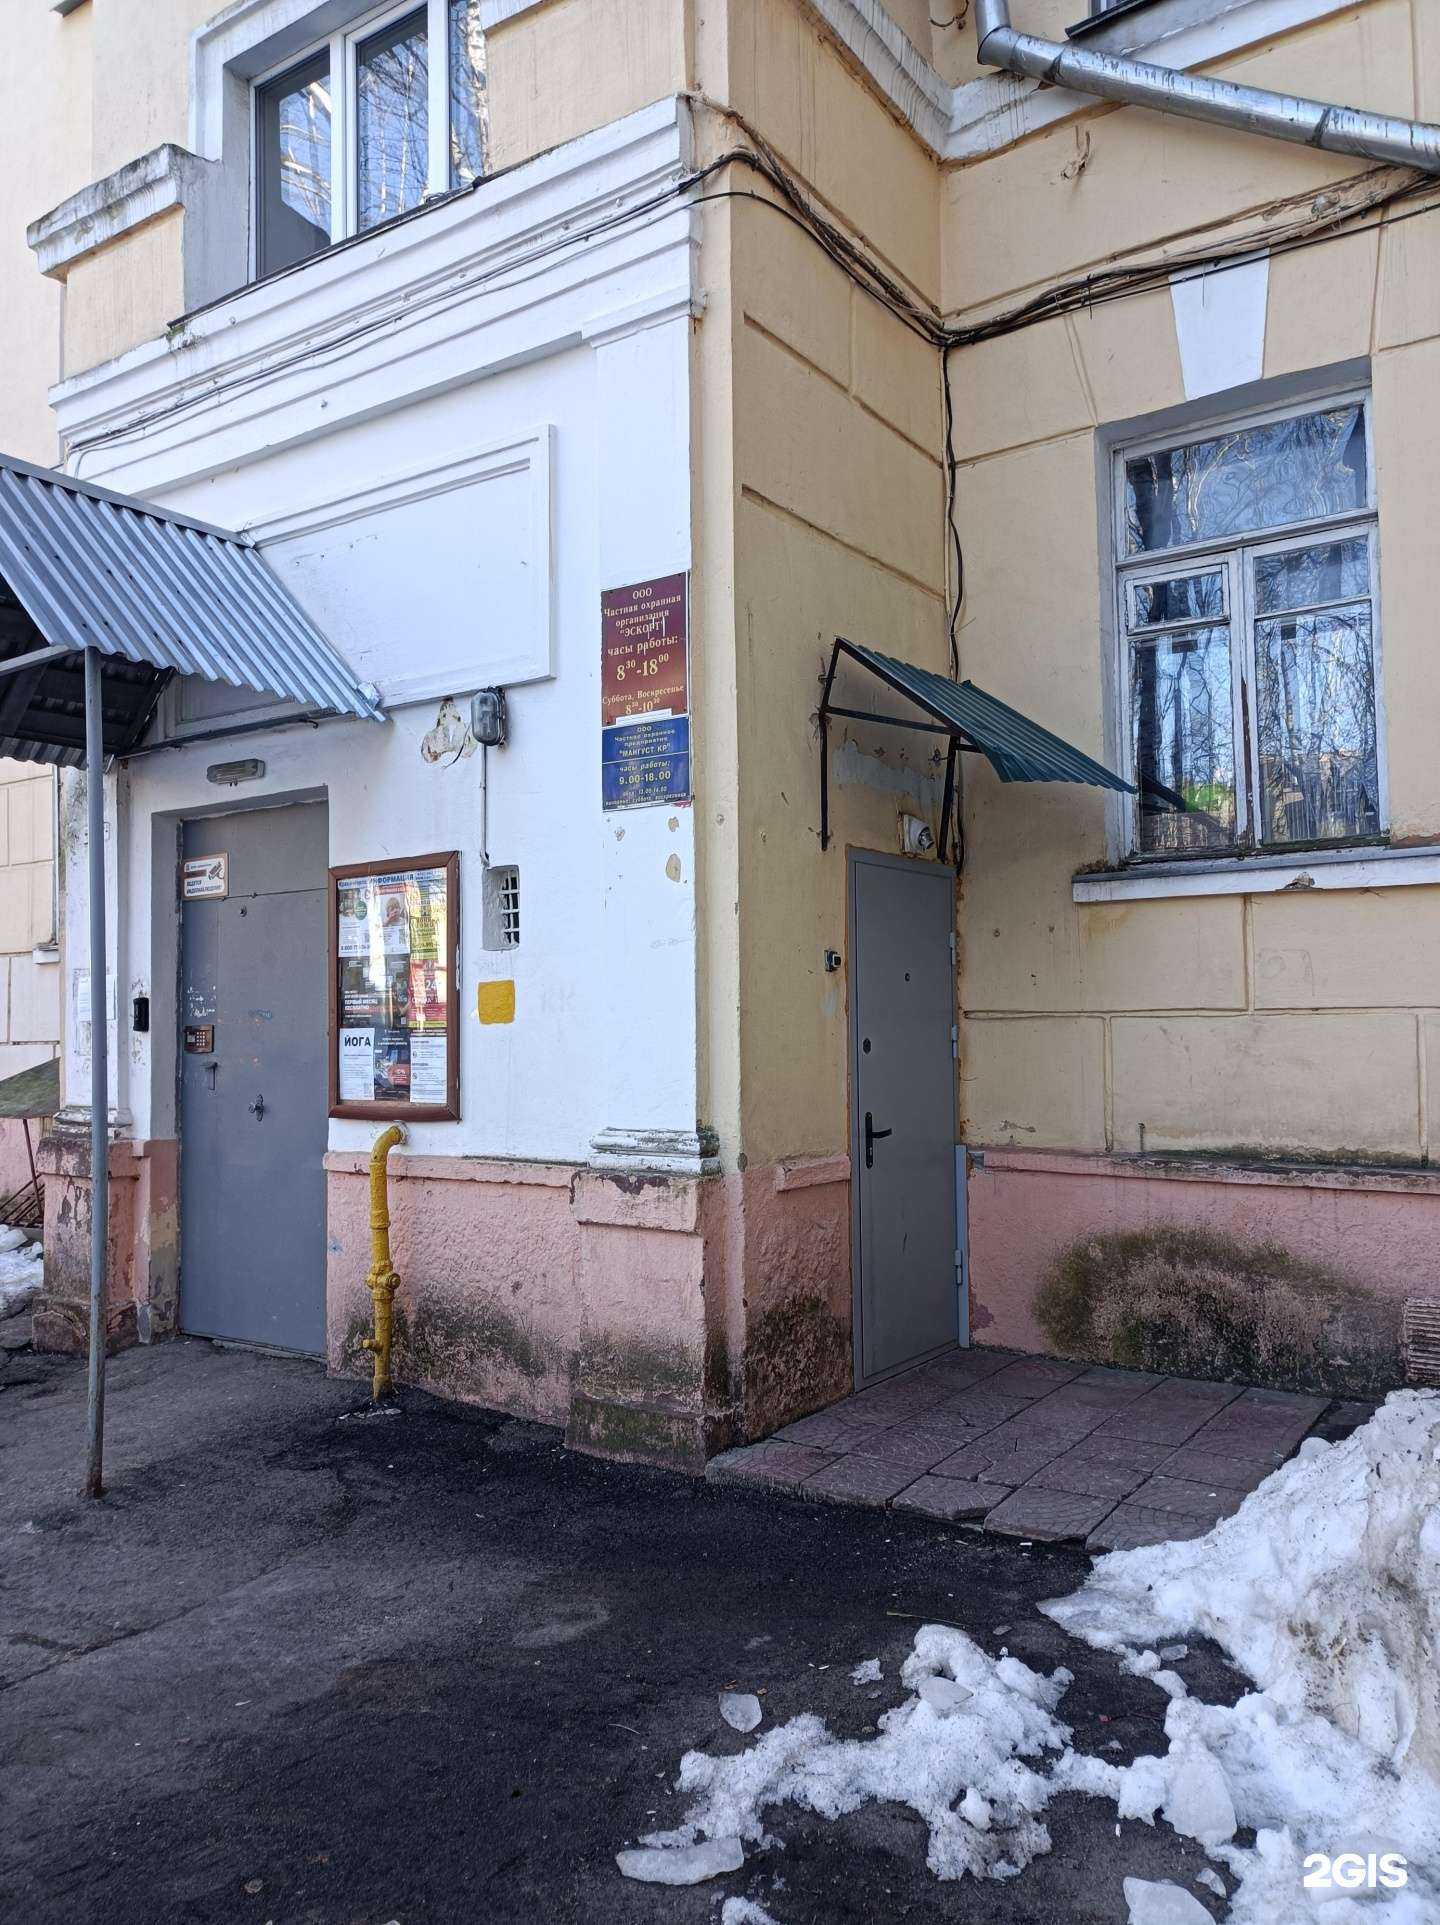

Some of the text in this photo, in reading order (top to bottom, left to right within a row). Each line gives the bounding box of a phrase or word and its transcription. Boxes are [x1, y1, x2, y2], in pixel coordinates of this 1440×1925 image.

[632, 588, 653, 600] ООО
[604, 594, 681, 617] Частная охранная
[615, 610, 670, 628] организация
[608, 636, 678, 657] часы работы:
[619, 771, 671, 785] 9.00-18.00
[344, 1034, 372, 1047] ЙОГА
